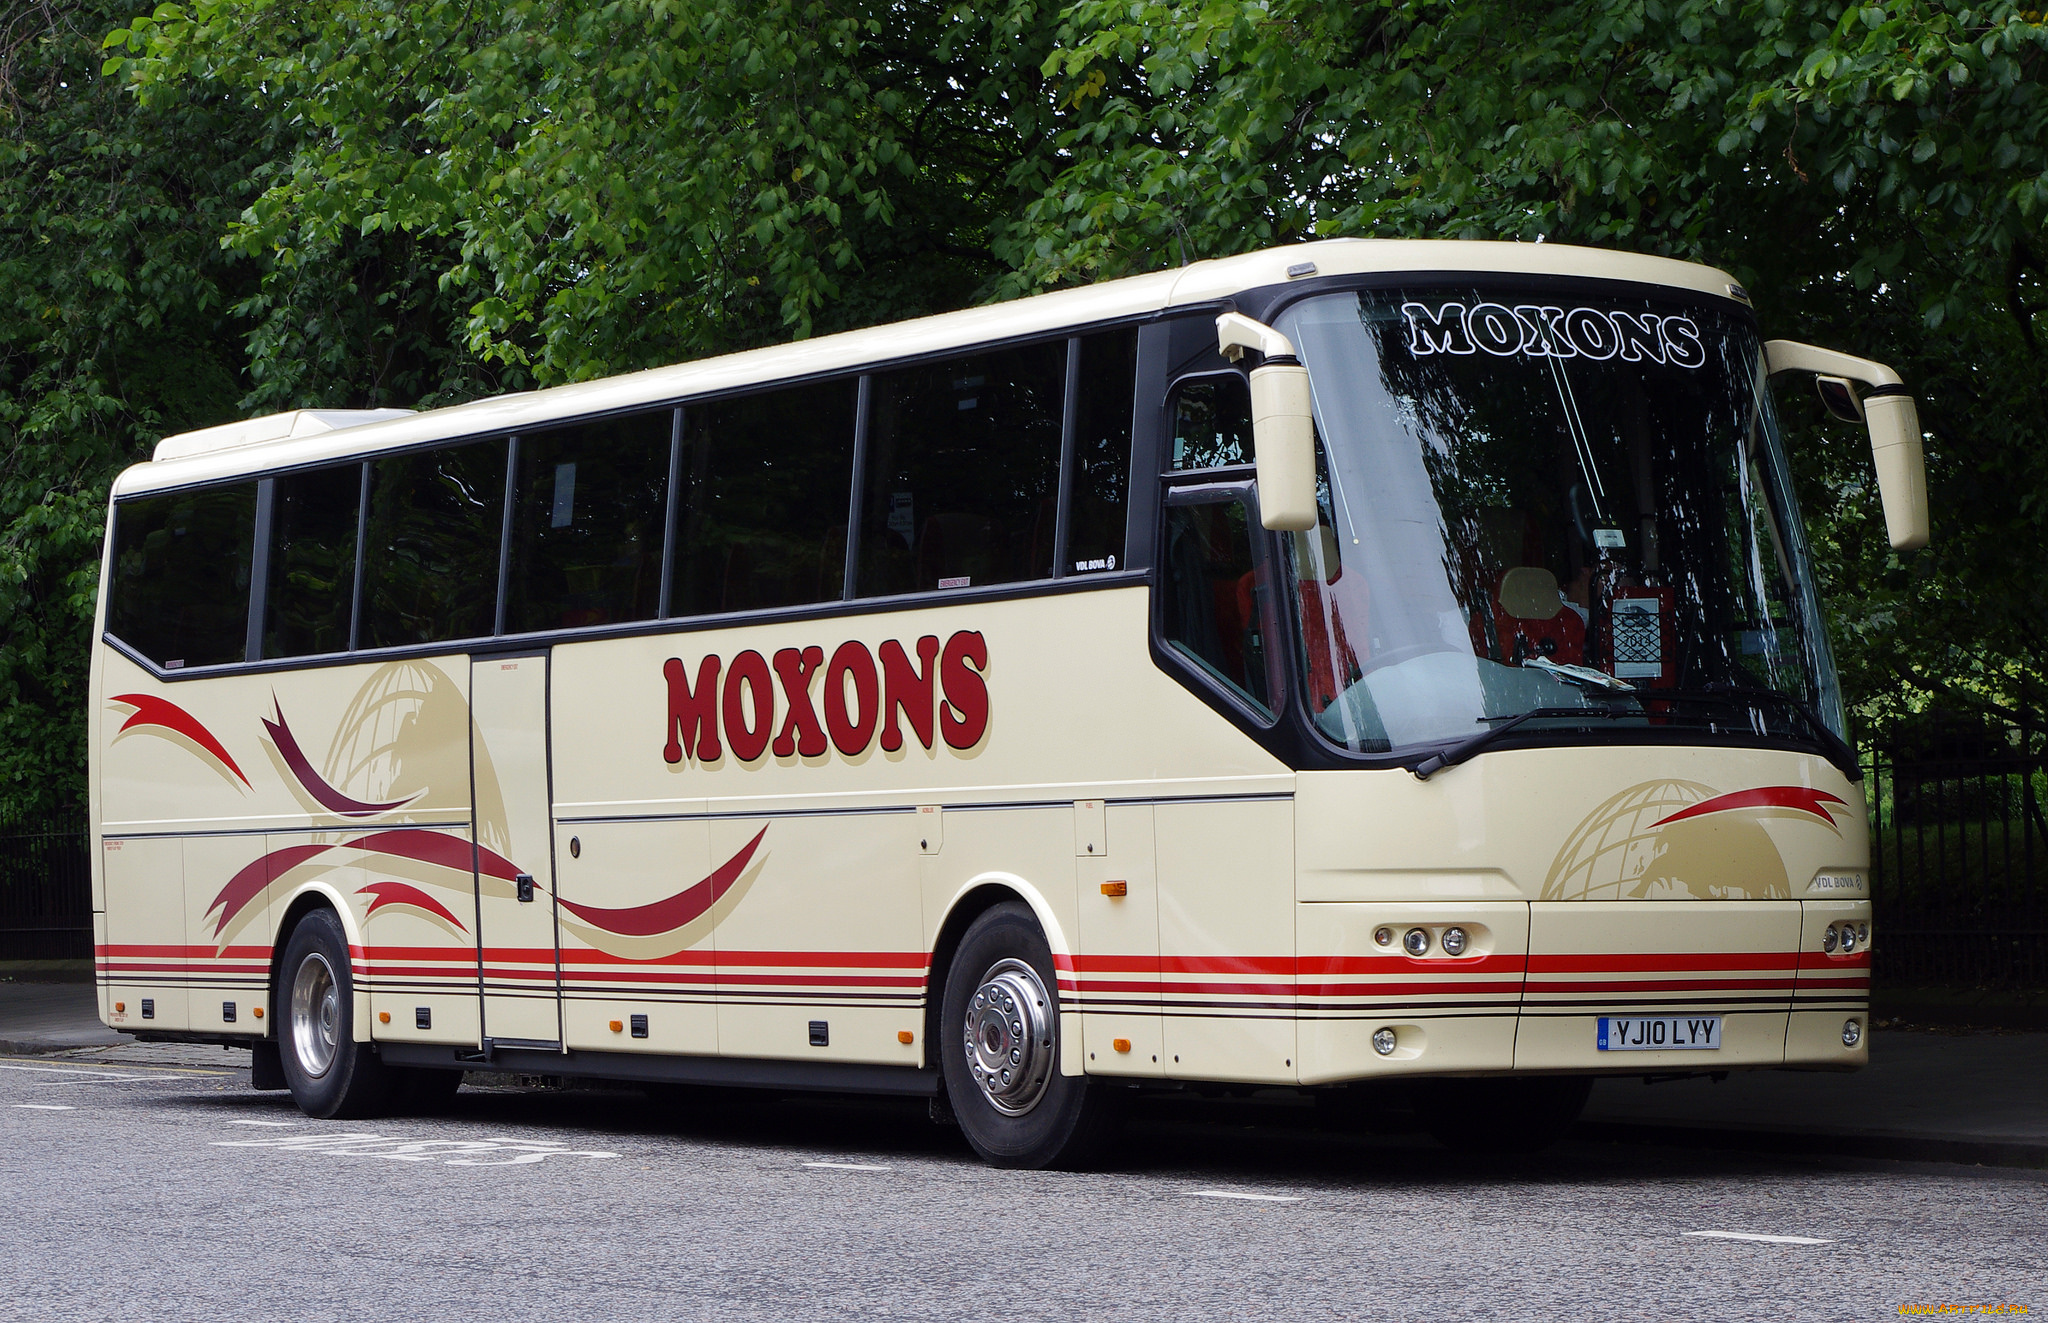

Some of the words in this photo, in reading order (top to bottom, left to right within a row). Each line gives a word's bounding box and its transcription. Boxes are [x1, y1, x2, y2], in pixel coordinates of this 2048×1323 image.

[1401, 302, 1707, 369] MOXONS
[1076, 561, 1088, 571] VDL
[1088, 559, 1105, 569] BOVA
[663, 630, 990, 764] MOXONS
[1815, 877, 1834, 888] VDL
[1834, 877, 1854, 888] BOVA
[1617, 1020, 1666, 1045] YJ10
[1672, 1019, 1715, 1044] LYY
